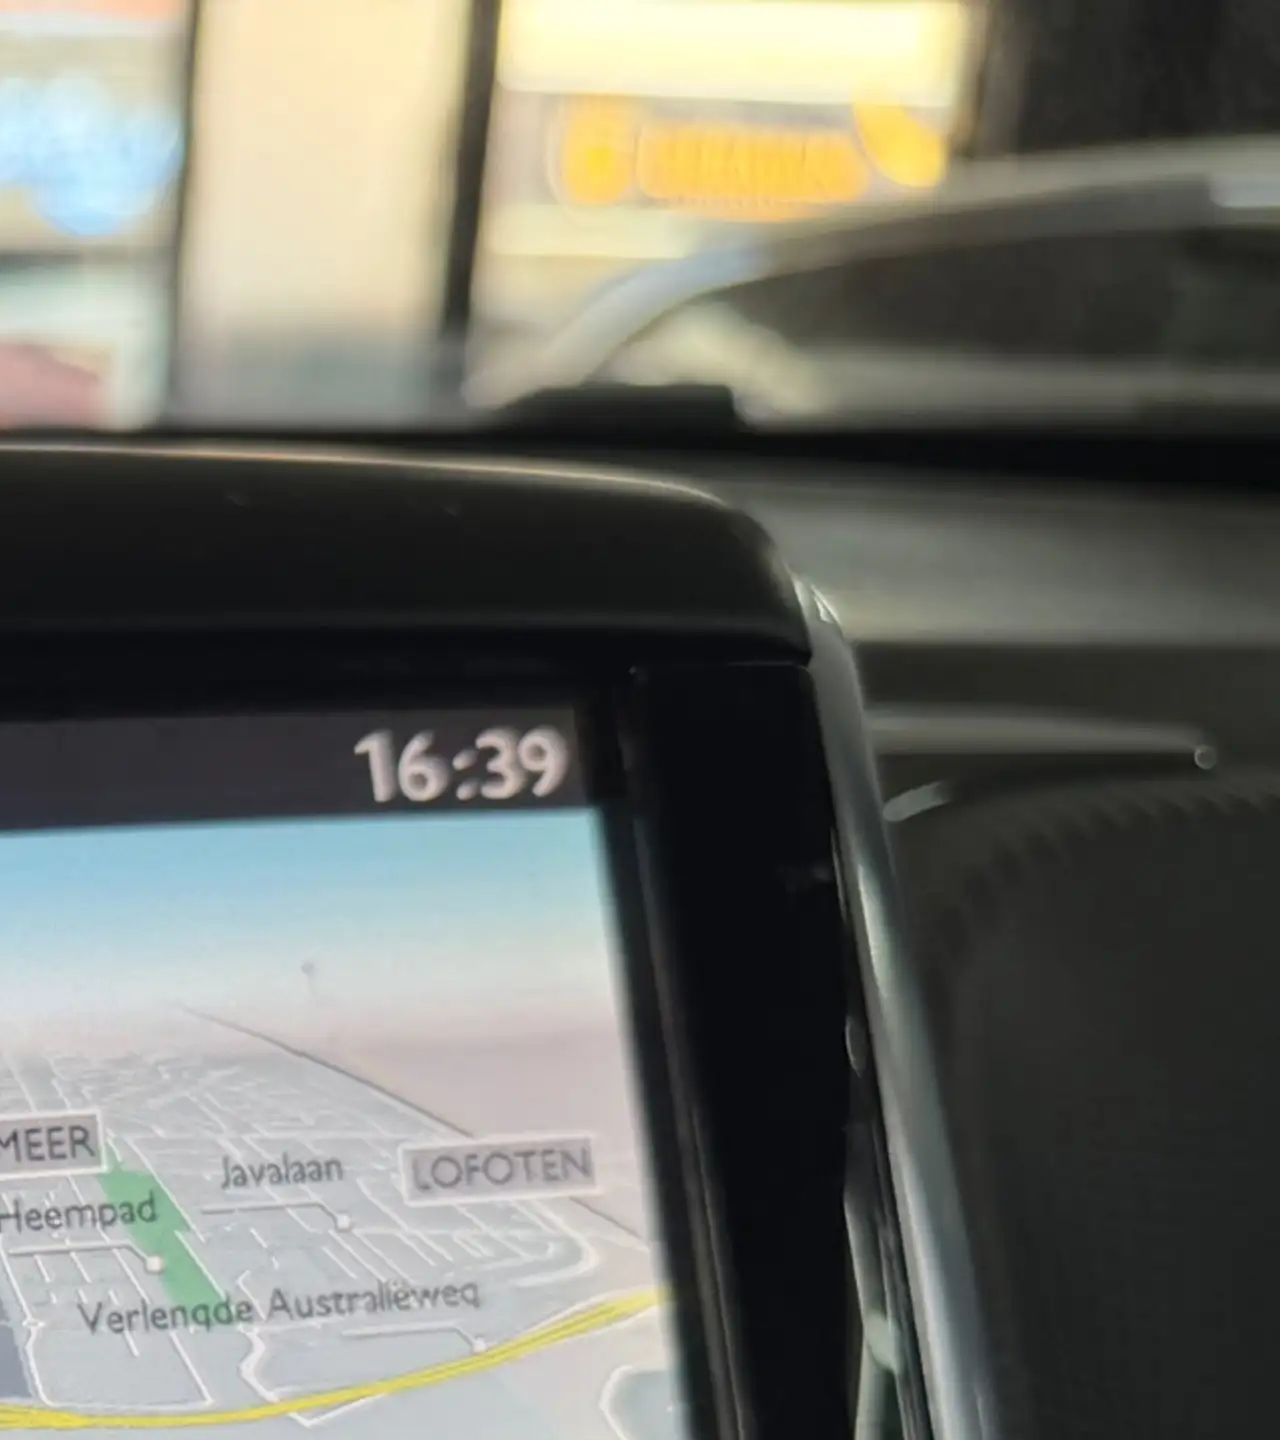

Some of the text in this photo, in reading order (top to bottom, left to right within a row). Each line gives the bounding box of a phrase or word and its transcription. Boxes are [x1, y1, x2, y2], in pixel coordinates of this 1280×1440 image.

[353, 726, 568, 802] 16:39
[221, 1155, 343, 1191] Javalaan
[412, 1147, 593, 1191] LOFOTEN
